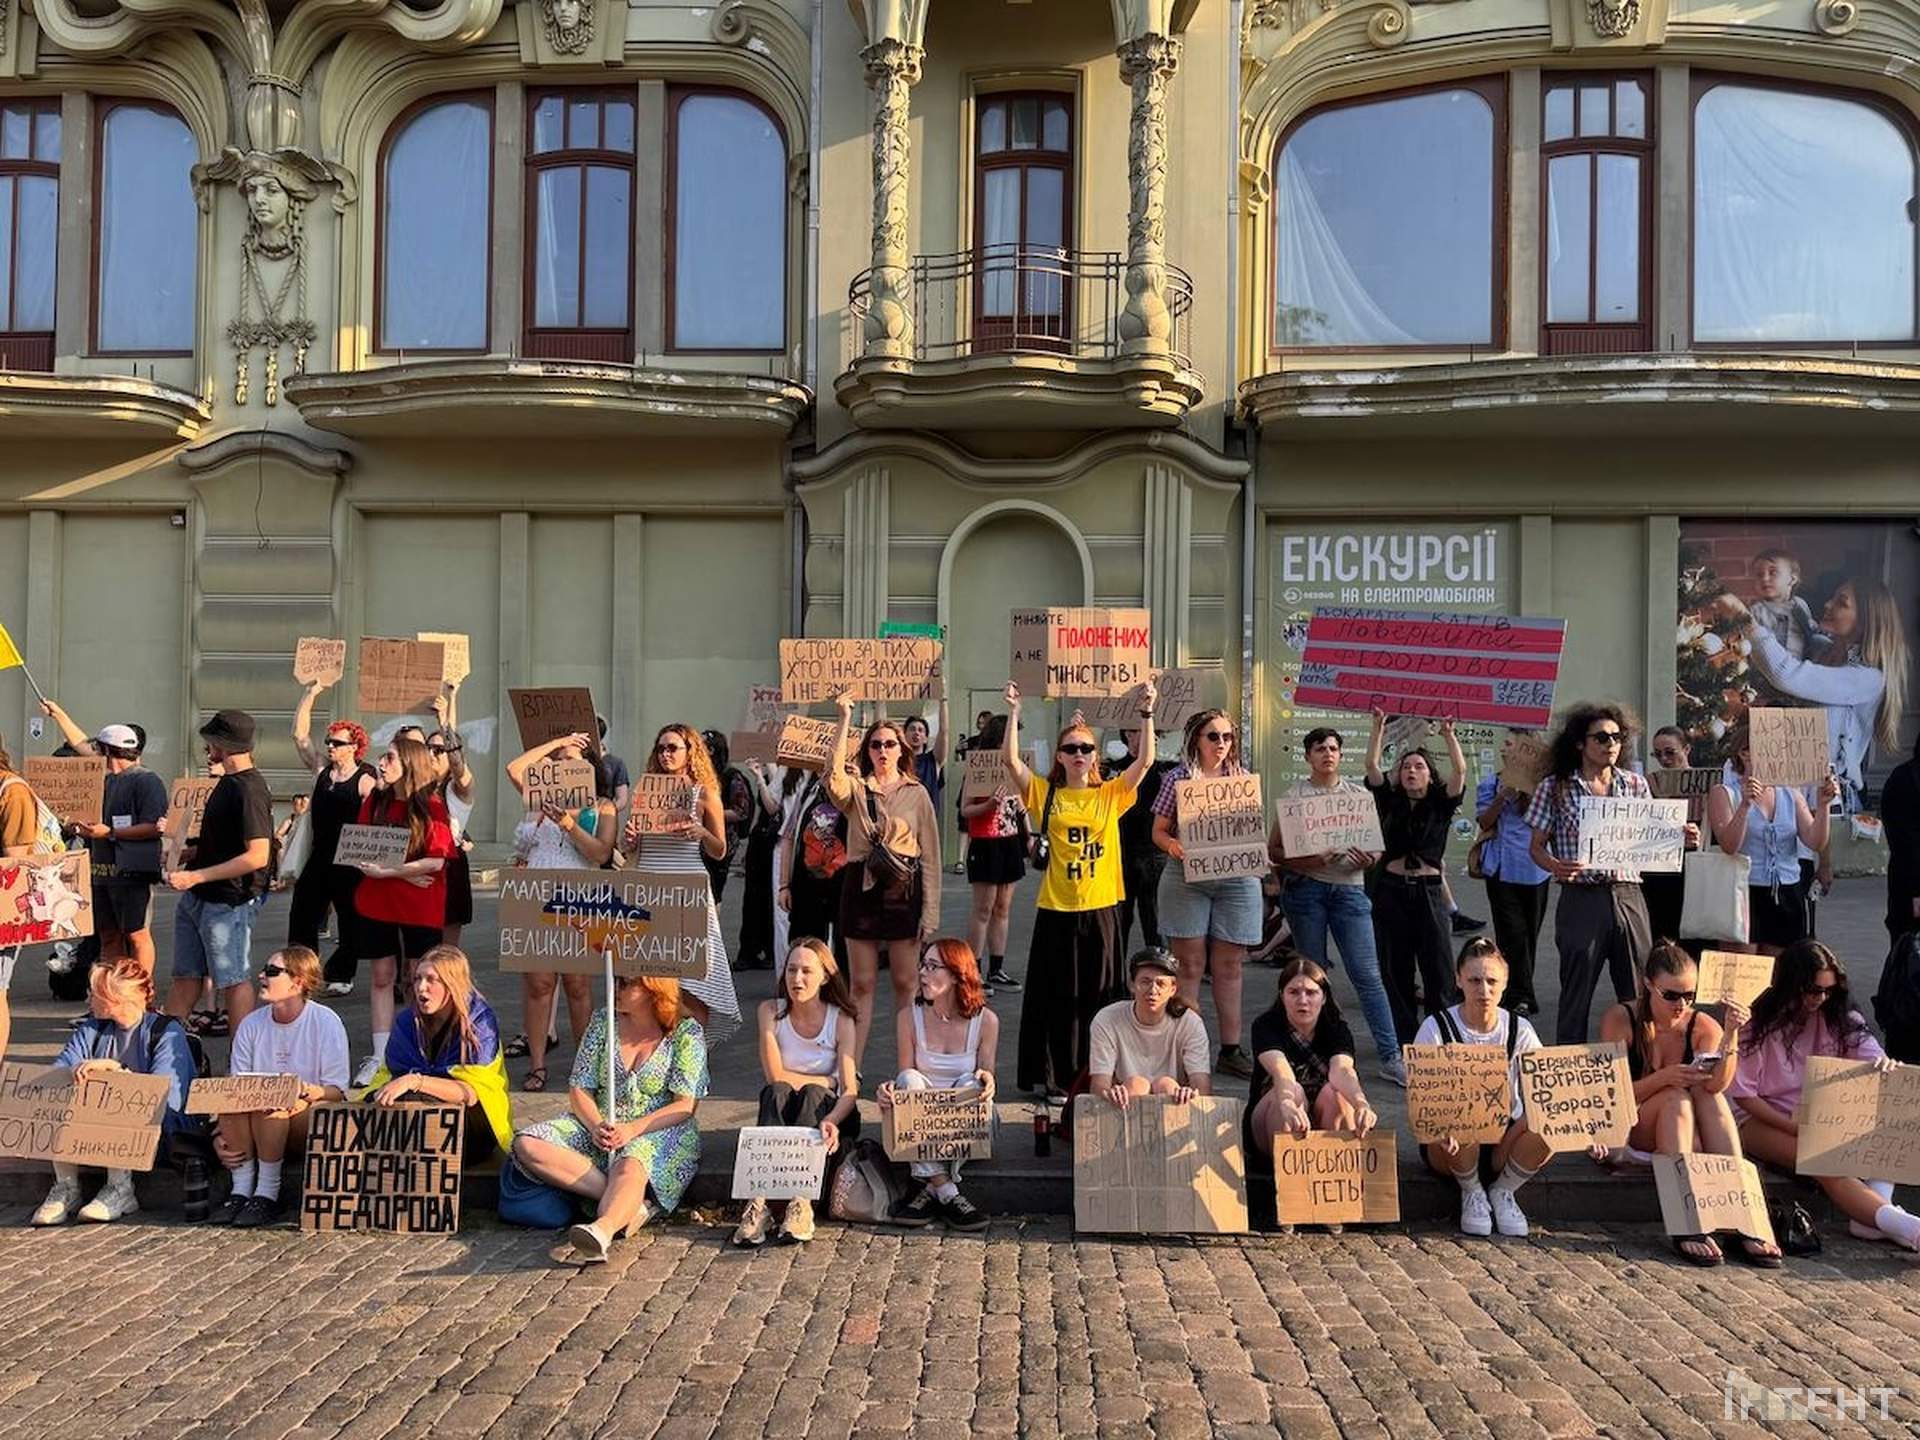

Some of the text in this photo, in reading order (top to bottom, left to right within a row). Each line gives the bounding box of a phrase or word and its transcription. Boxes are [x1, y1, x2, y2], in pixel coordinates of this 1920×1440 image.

[1283, 528, 1496, 582] ЕКСКУРСІЇ
[1013, 613, 1065, 626] МІНЯЙТЕ
[1057, 627, 1148, 648] ПОЛОНЕНИХ
[794, 641, 917, 660] СТОЮ ЗА ТИХ
[1015, 650, 1042, 661] А НЕ
[786, 659, 942, 679] ХТО НАС ЗАХИЩАЄ
[1047, 663, 1137, 685] МІНІСТРІВ!
[802, 683, 819, 699] НЕ
[865, 679, 930, 699] ПРИЙТИ
[528, 765, 560, 786] ВСЕ
[1190, 850, 1265, 875] ФЕДОРОВА
[501, 880, 708, 907] МАЛЕНЬКИЙ ГВИНТИК
[552, 905, 641, 931] ТРИМАЄ
[501, 927, 708, 963] ВЕЛИКИЙ МЕХАНІЗМ
[1533, 1069, 1616, 1089] ПОТРІБЕН
[915, 1091, 956, 1104] МОЖЕТЕ
[309, 1108, 460, 1154] ДОЖИЛИСЯ
[918, 1142, 971, 1159] НІКОЛИ
[1282, 1147, 1377, 1175] СИРСЬКОГО
[1841, 1150, 1906, 1169] МЕНЕ
[305, 1153, 459, 1194] ПОВЕРНІТЬ
[1312, 1178, 1364, 1205] ГЕТЬ!
[305, 1194, 456, 1232] ФЕДОРОВА
